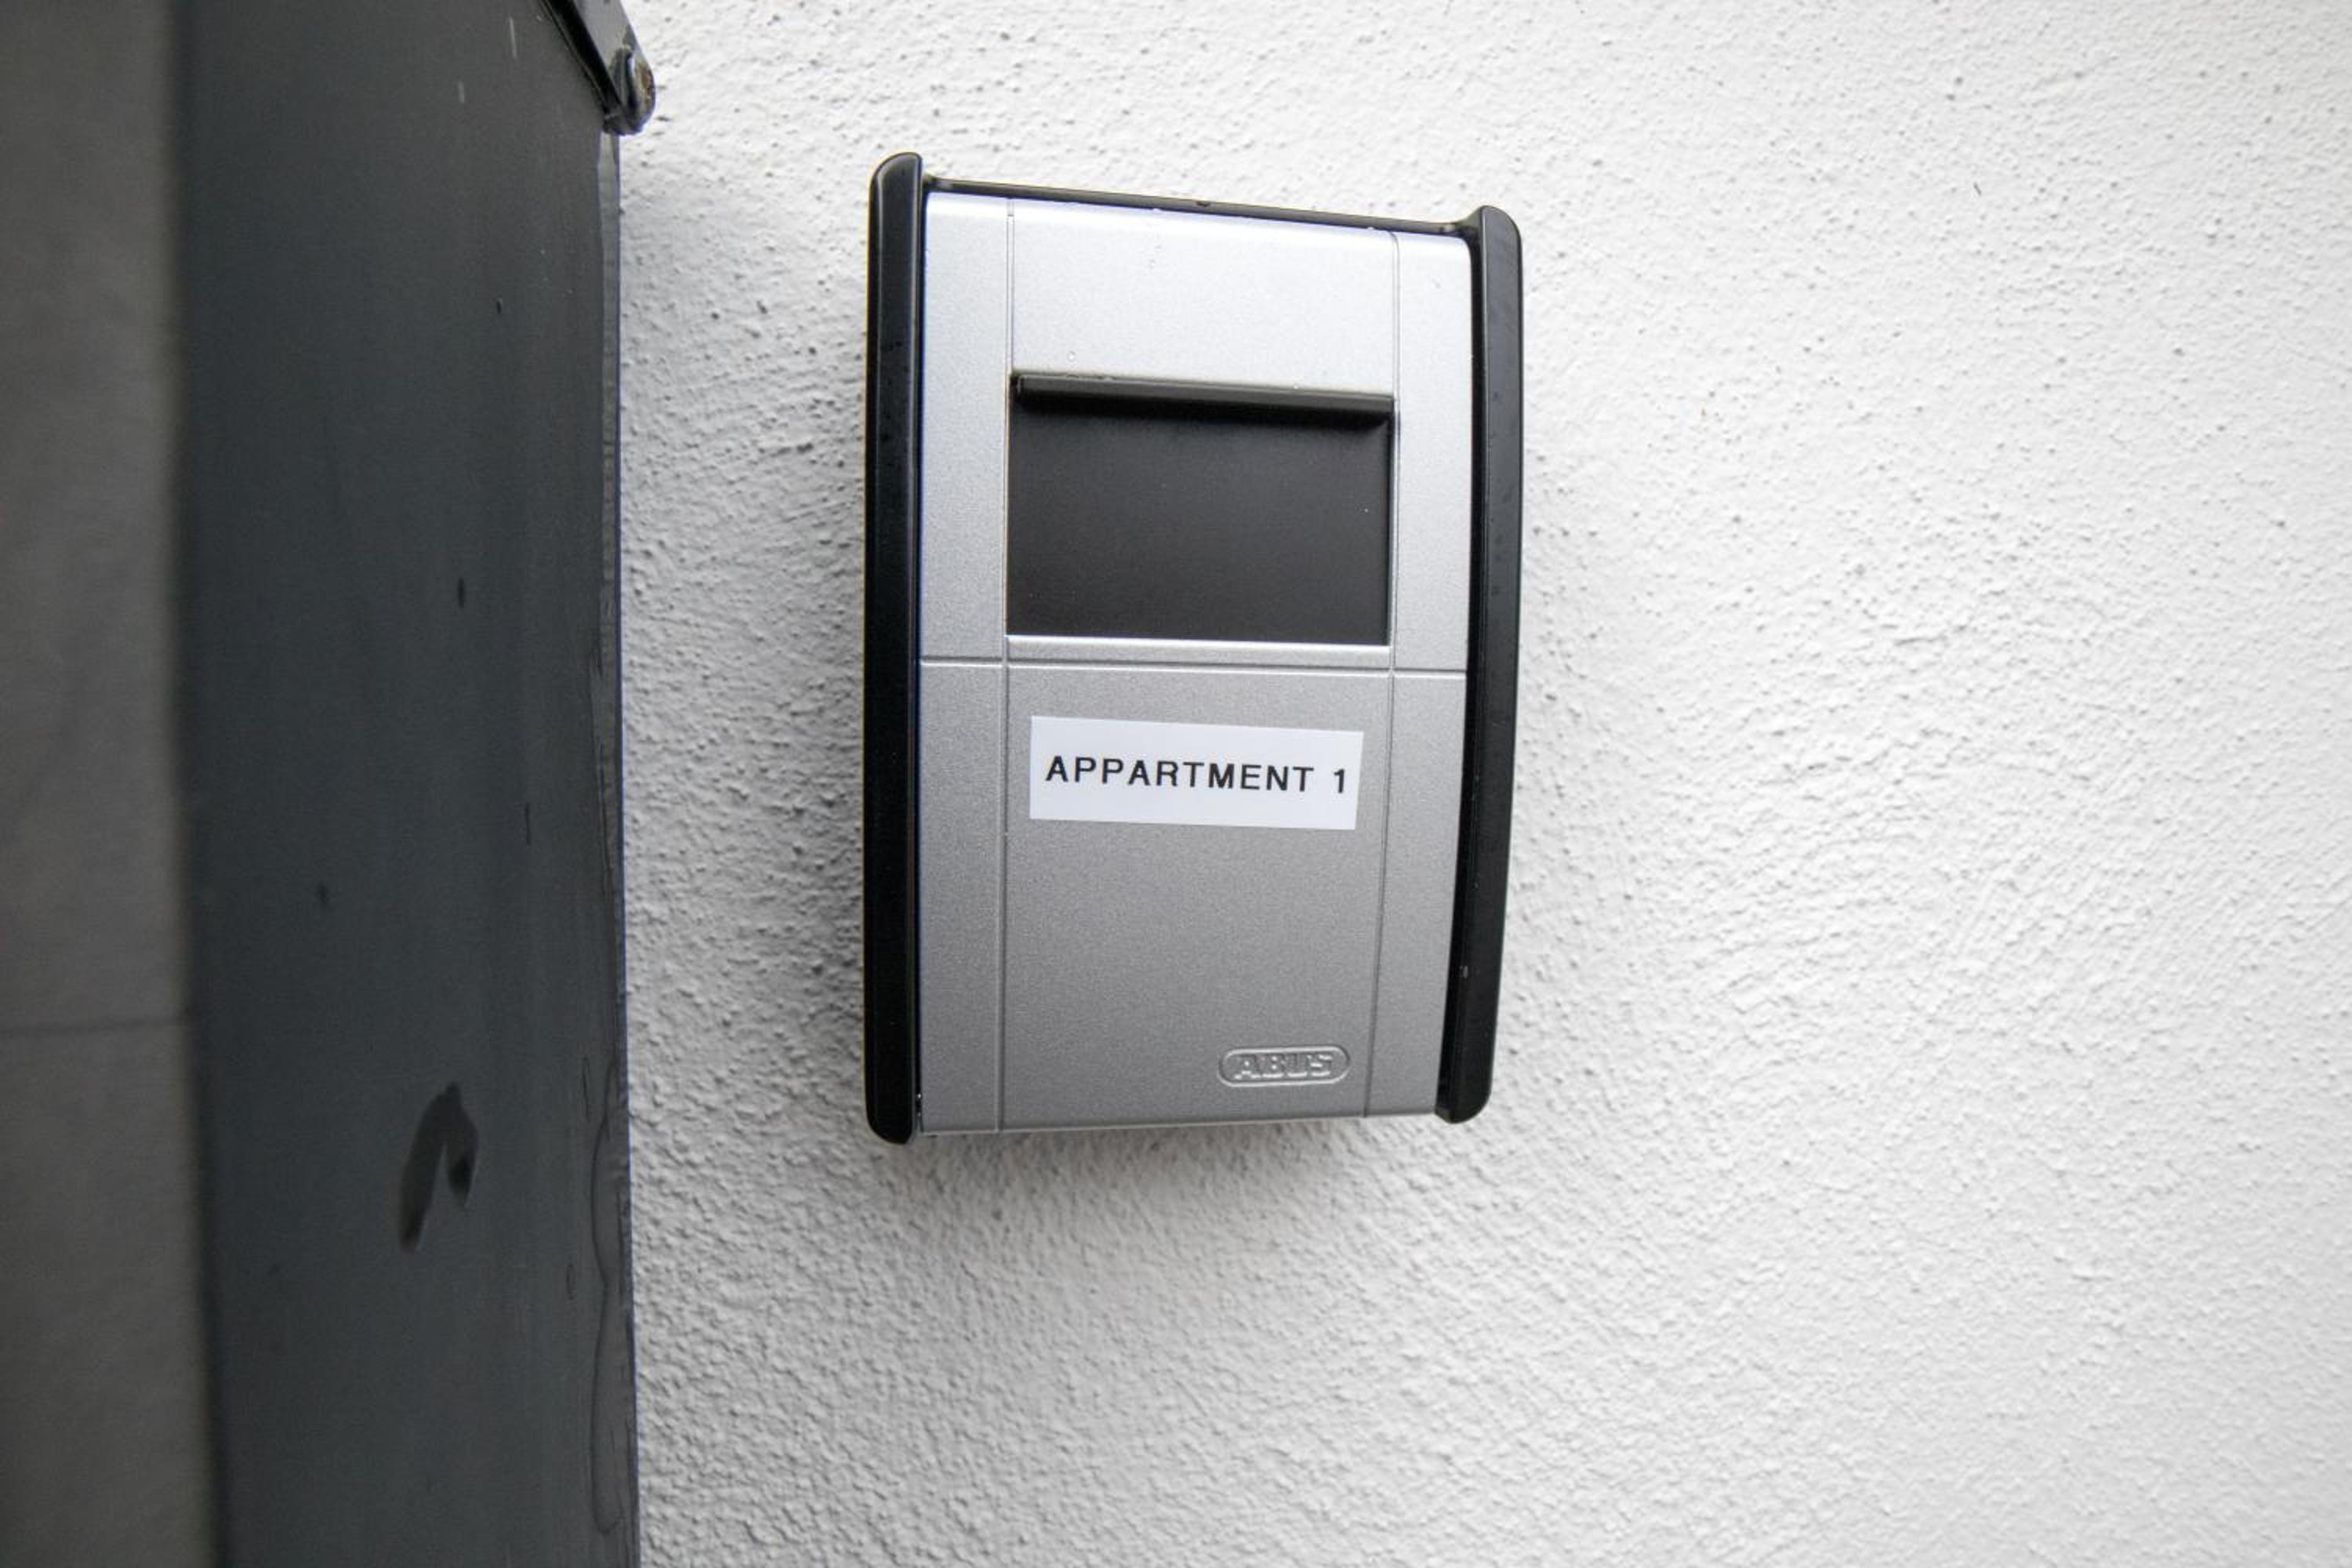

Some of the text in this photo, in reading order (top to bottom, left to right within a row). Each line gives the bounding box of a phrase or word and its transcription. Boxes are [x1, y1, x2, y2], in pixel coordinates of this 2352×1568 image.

[1045, 755, 1346, 794] APPARTMENT 1
[1232, 1053, 1333, 1080] ABUS
